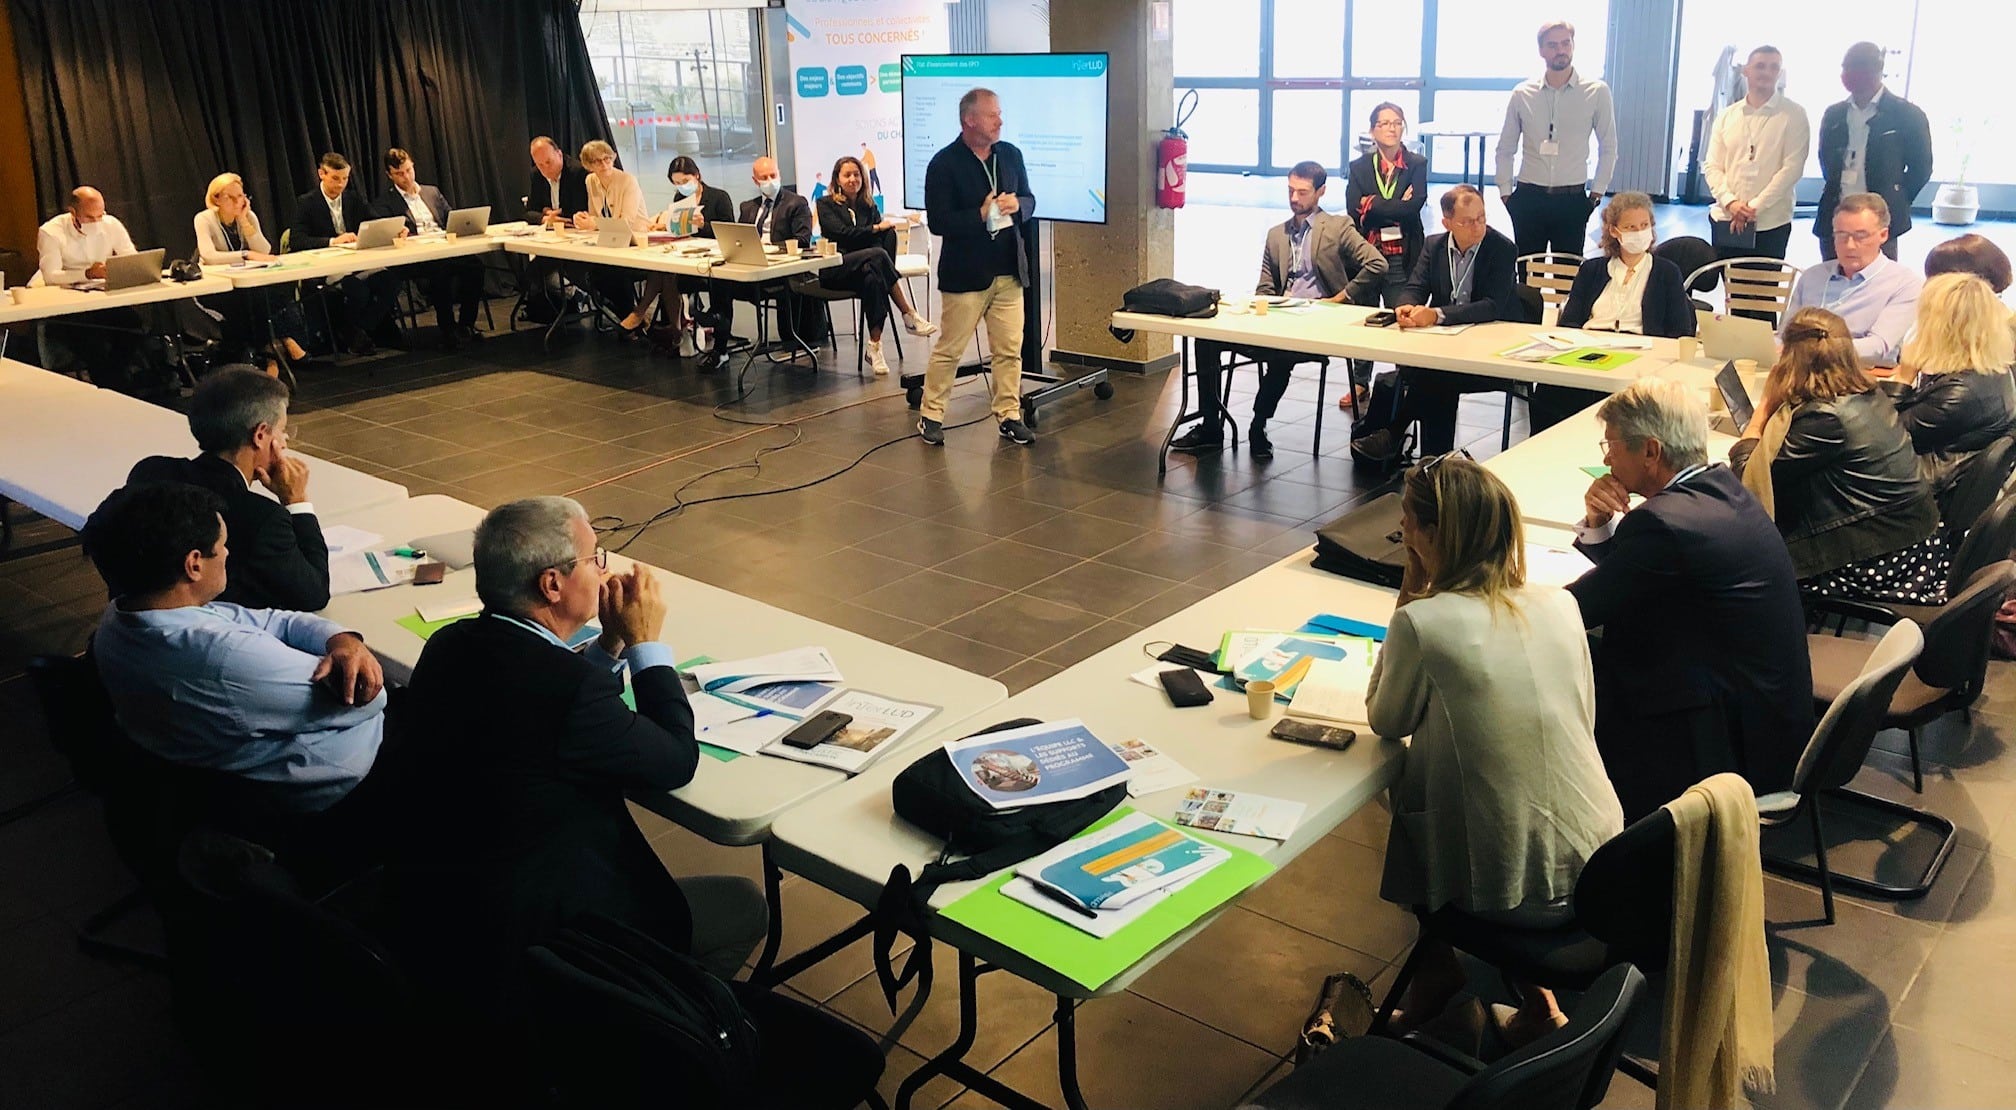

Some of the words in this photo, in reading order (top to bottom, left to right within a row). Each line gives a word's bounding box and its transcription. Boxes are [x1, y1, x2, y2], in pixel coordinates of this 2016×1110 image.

[825, 33, 855, 45] TOUS
[857, 29, 920, 44] CONCERNÉS
[877, 131, 889, 141] DU
[1048, 743, 1087, 756] SUPPORTS
[1044, 752, 1095, 771] PROGRAMME
